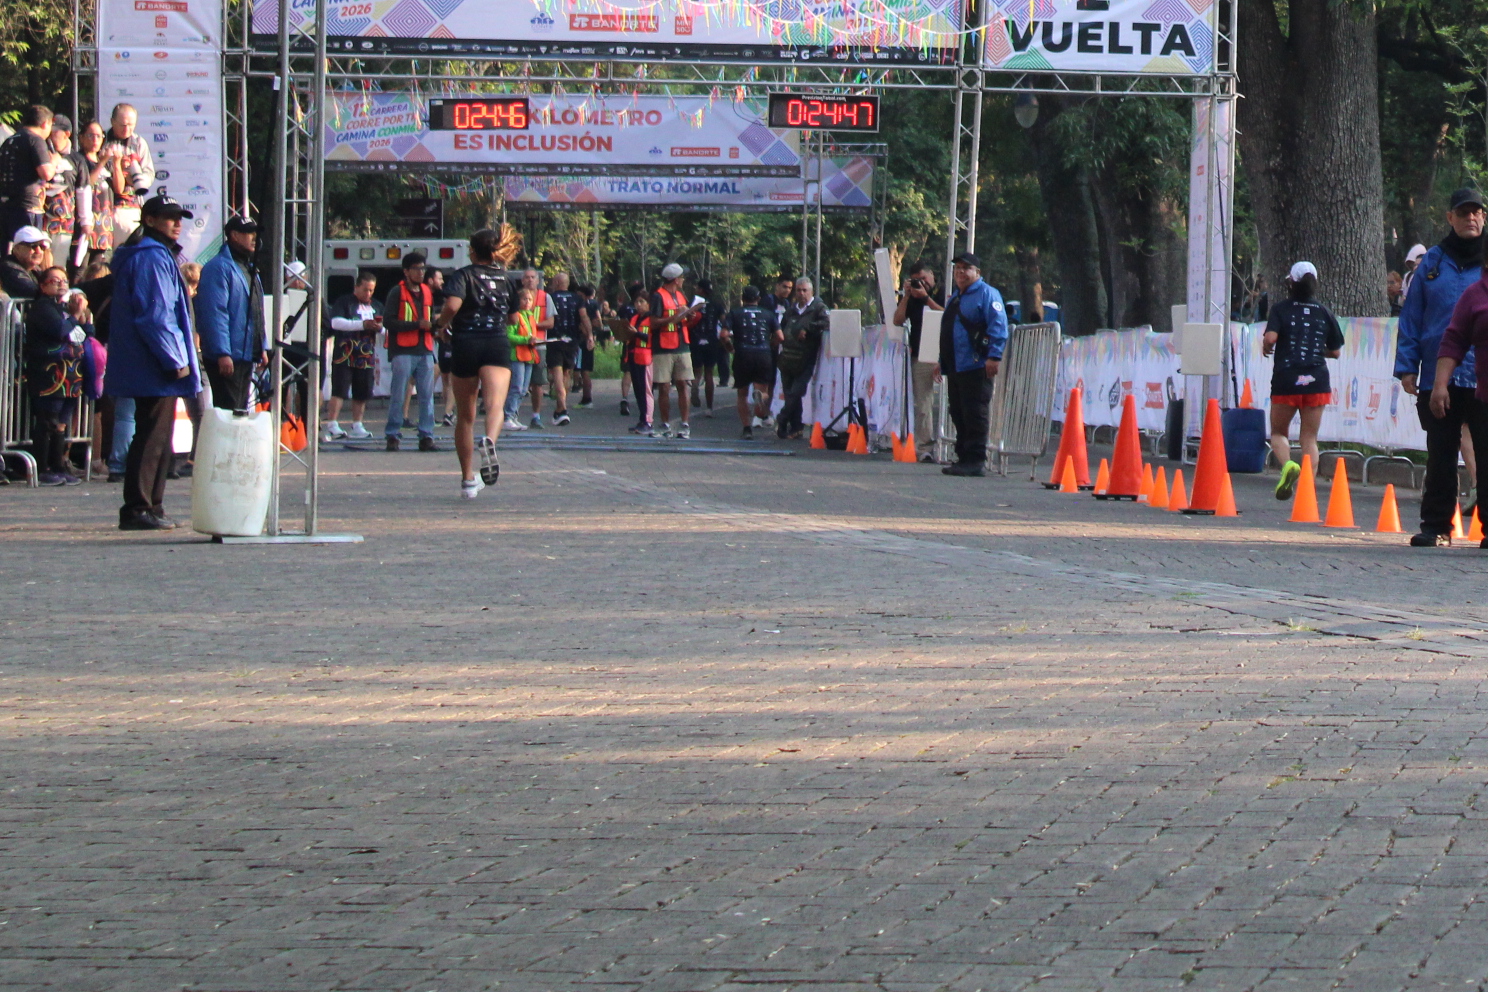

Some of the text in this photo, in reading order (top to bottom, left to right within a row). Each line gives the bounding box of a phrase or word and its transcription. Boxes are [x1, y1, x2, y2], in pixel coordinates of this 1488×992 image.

[341, 2, 372, 17] 2026
[1004, 20, 1197, 57] VUELTA
[370, 103, 408, 116] CARRERA
[346, 118, 381, 131] CORRE
[383, 114, 402, 126] POR
[336, 129, 376, 143] CAMINA
[453, 131, 613, 152] ES INCLUSIÓN
[369, 138, 391, 149] 2026
[607, 181, 741, 195] TRATO NORMAL
